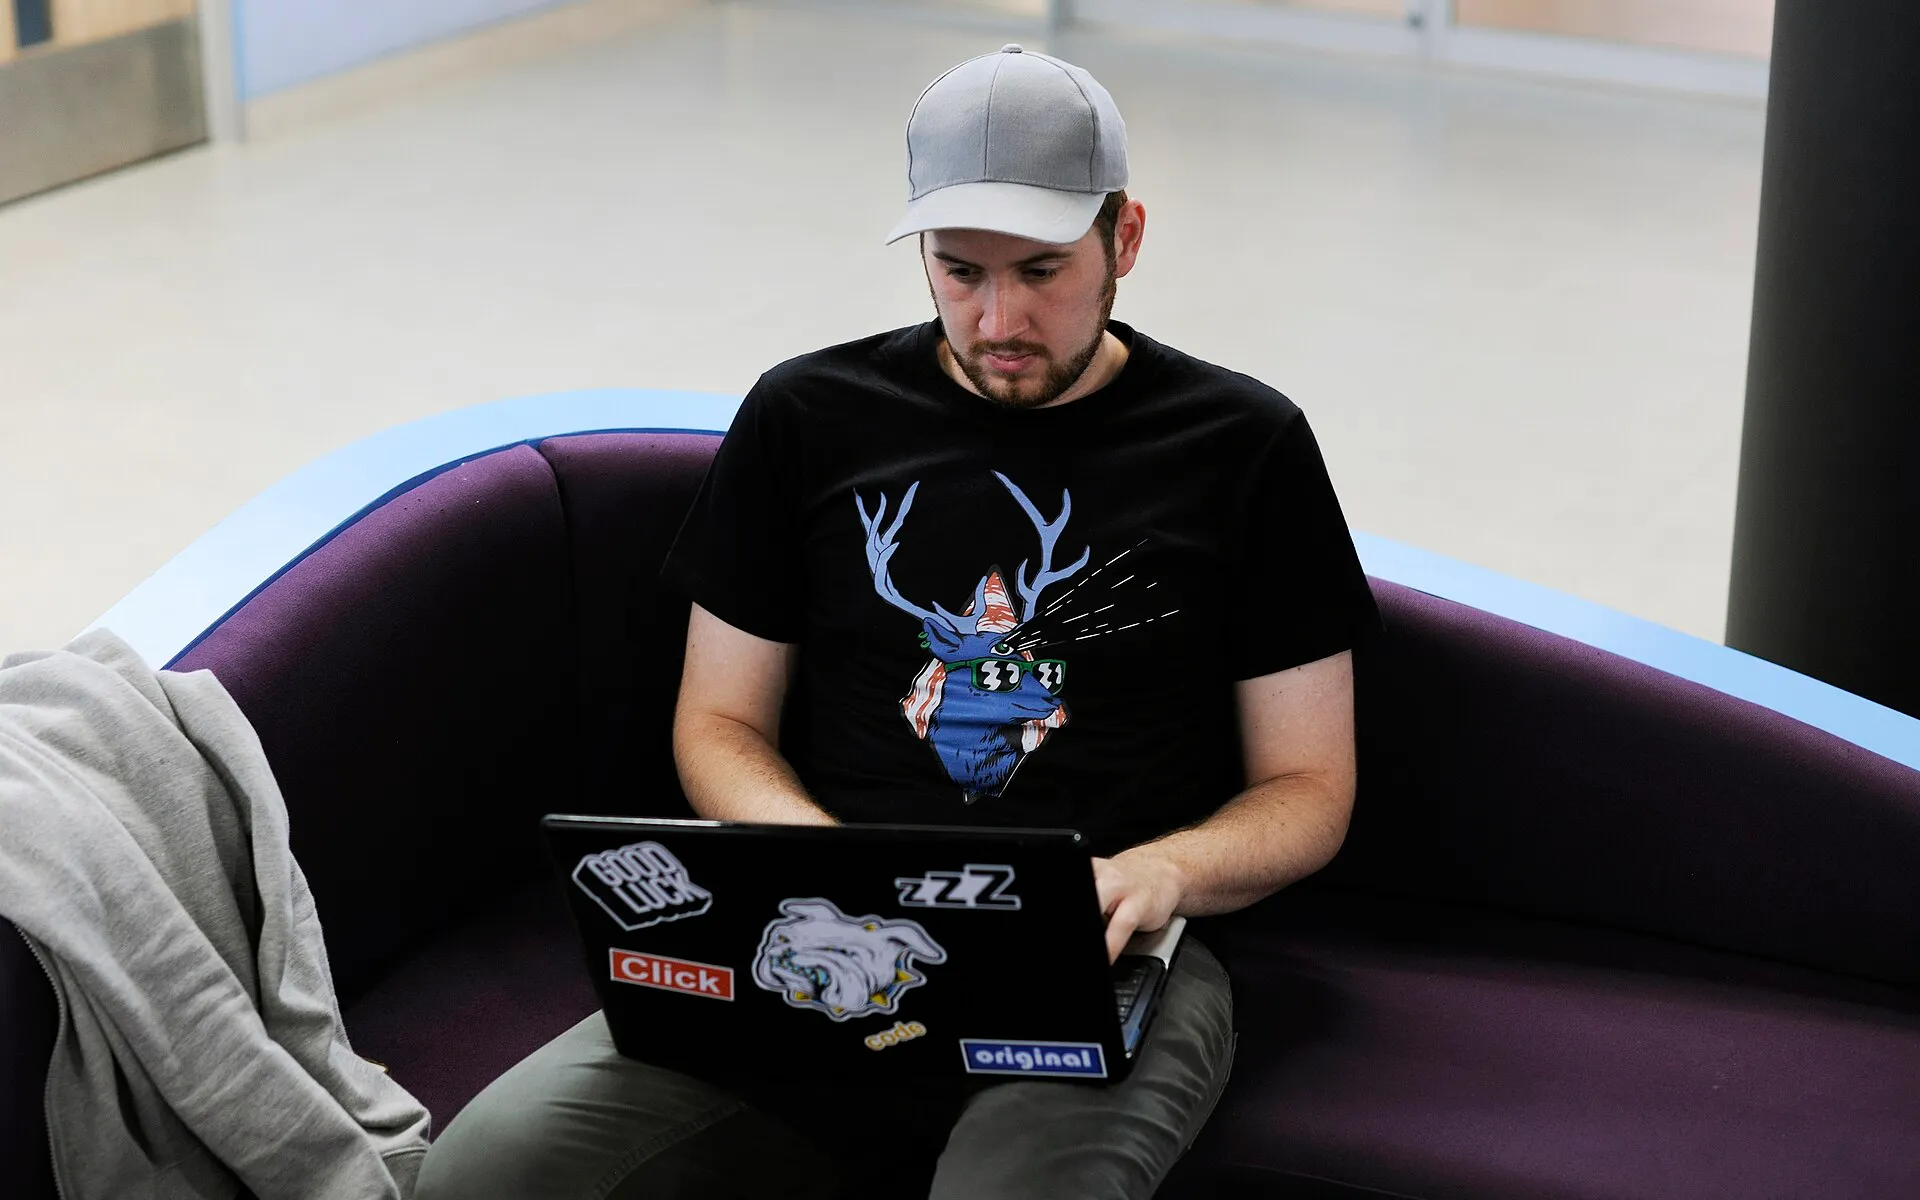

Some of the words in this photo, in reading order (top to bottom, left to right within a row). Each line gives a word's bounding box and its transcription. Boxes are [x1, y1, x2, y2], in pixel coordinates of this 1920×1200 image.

[586, 847, 677, 887] GOOD
[612, 872, 707, 914] LUCK
[621, 957, 720, 994] Click
[865, 1021, 926, 1050] code
[975, 1046, 1092, 1070] original
